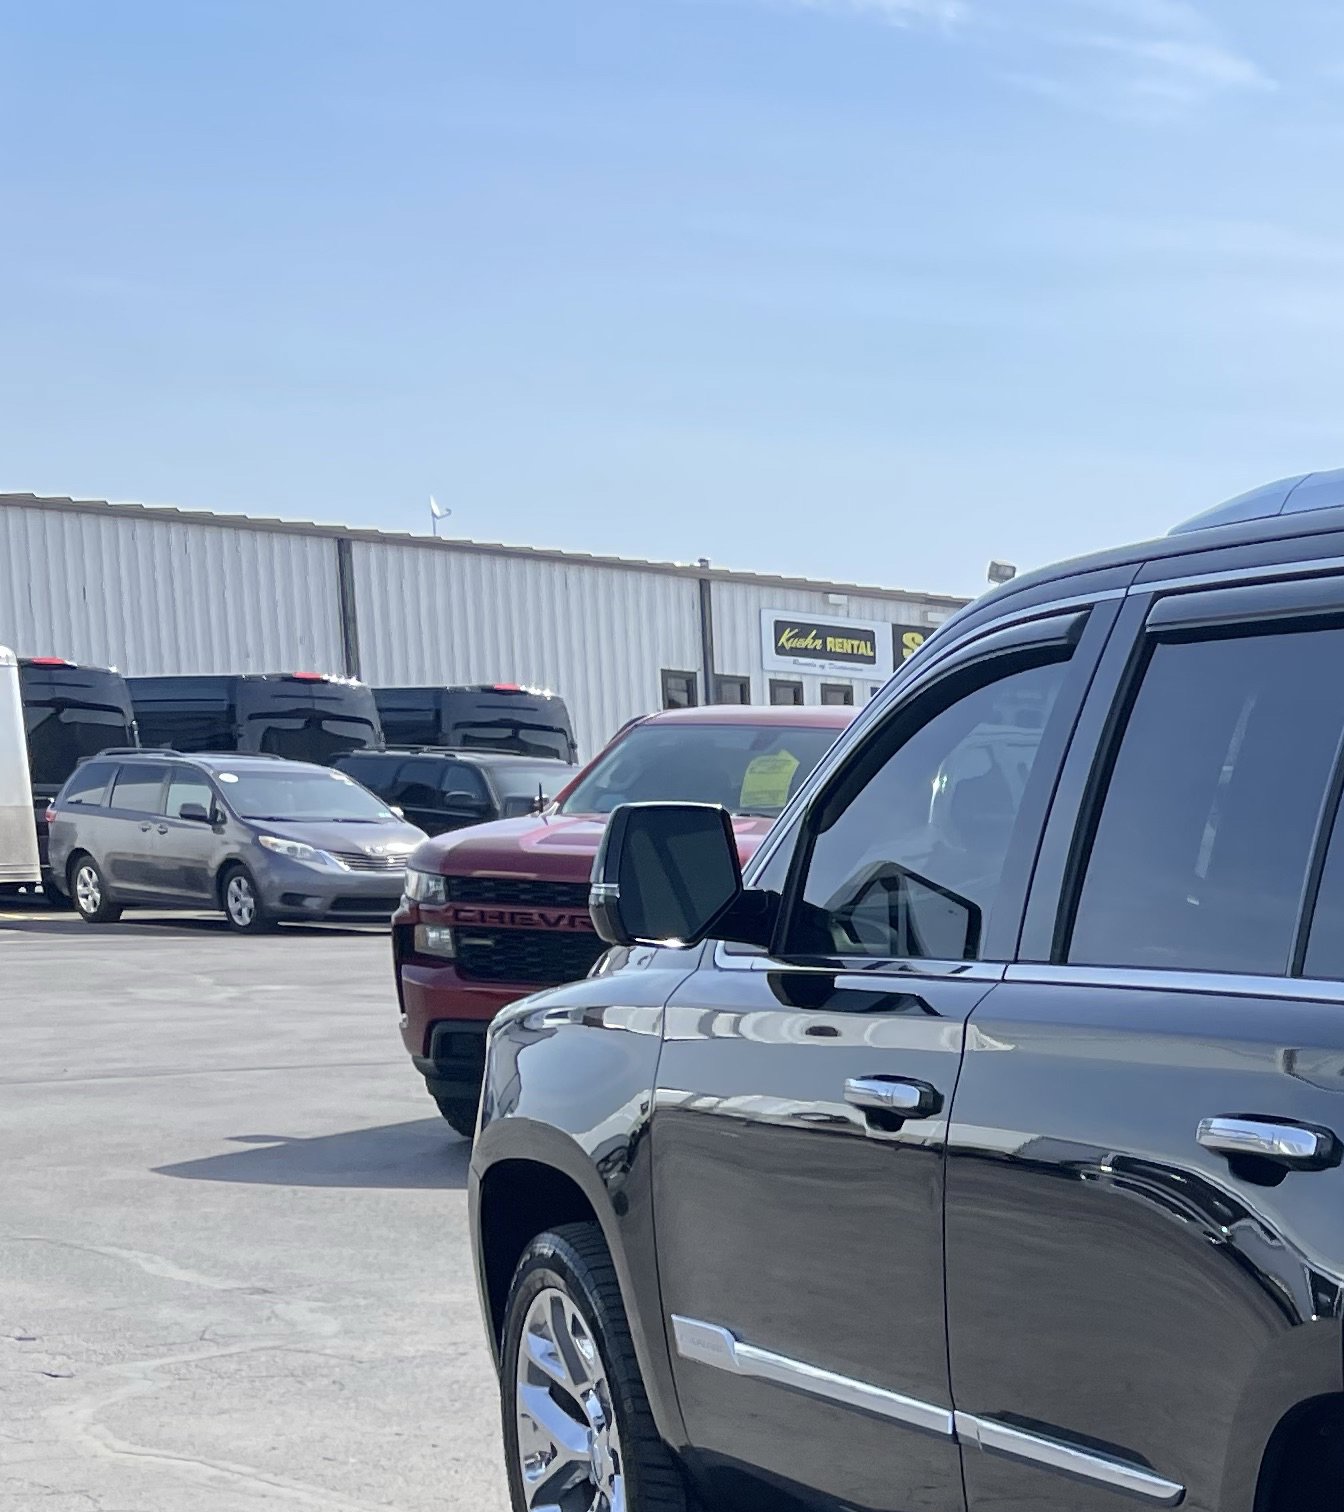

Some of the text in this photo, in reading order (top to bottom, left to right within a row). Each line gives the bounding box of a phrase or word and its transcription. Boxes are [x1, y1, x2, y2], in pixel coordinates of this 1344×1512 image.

[778, 628, 874, 656] Kuehn RENTAL
[453, 910, 597, 930] CHEVR
